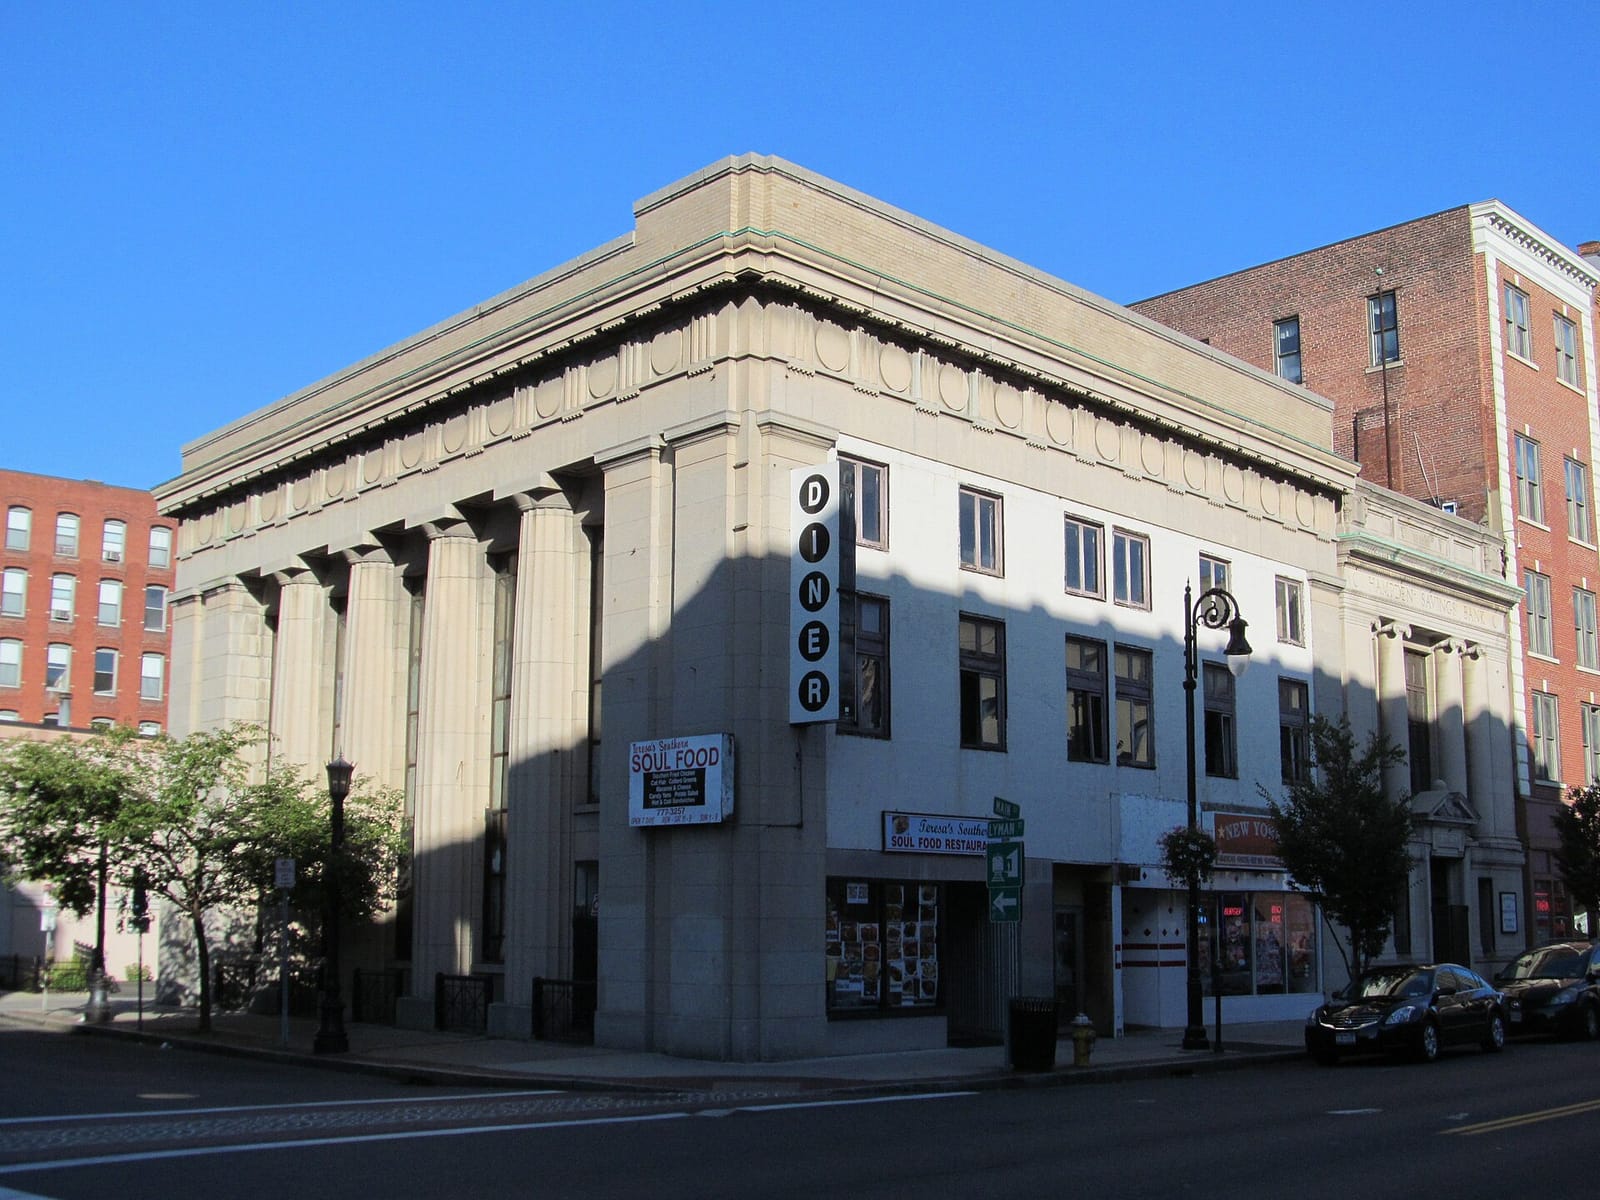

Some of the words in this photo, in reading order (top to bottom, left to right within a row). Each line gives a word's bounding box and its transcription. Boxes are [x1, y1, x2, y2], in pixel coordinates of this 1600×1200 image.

[806, 479, 824, 706] DINER
[1421, 592, 1457, 617] SAVINGS
[632, 752, 671, 773] SOUL
[676, 747, 719, 768] FOOD
[995, 799, 1011, 817] MAIN
[919, 819, 954, 835] Teresa's
[988, 821, 1015, 838] LYMAN
[1224, 821, 1249, 841] NEW
[1252, 820, 1281, 842] YOR
[891, 835, 915, 848] SOUL
[918, 837, 942, 849] FOOD
[945, 838, 987, 851] RESTAURA
